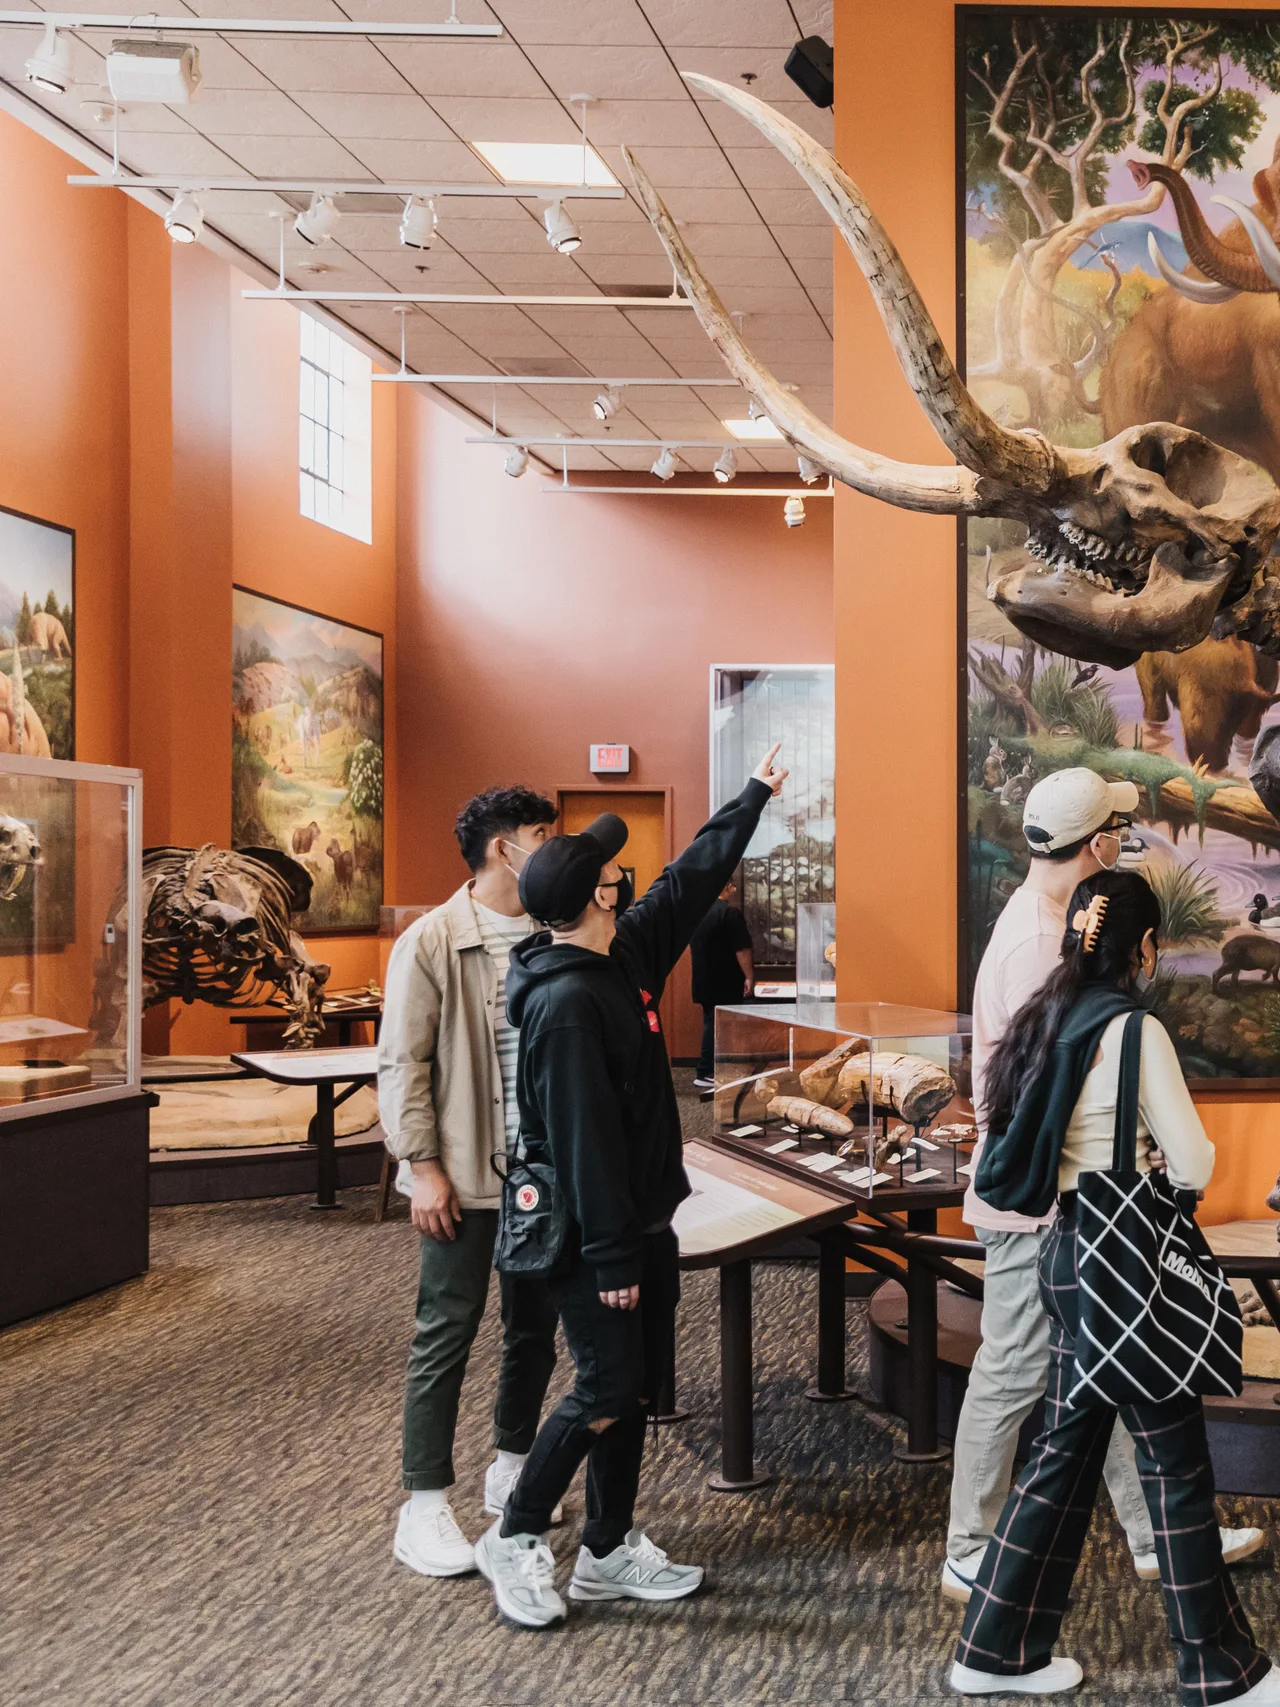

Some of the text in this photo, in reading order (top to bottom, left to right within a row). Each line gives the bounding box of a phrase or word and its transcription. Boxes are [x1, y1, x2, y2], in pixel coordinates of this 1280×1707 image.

[598, 748, 623, 767] EXIT
[1165, 1250, 1213, 1302] MoMA
[625, 1565, 651, 1585] N
